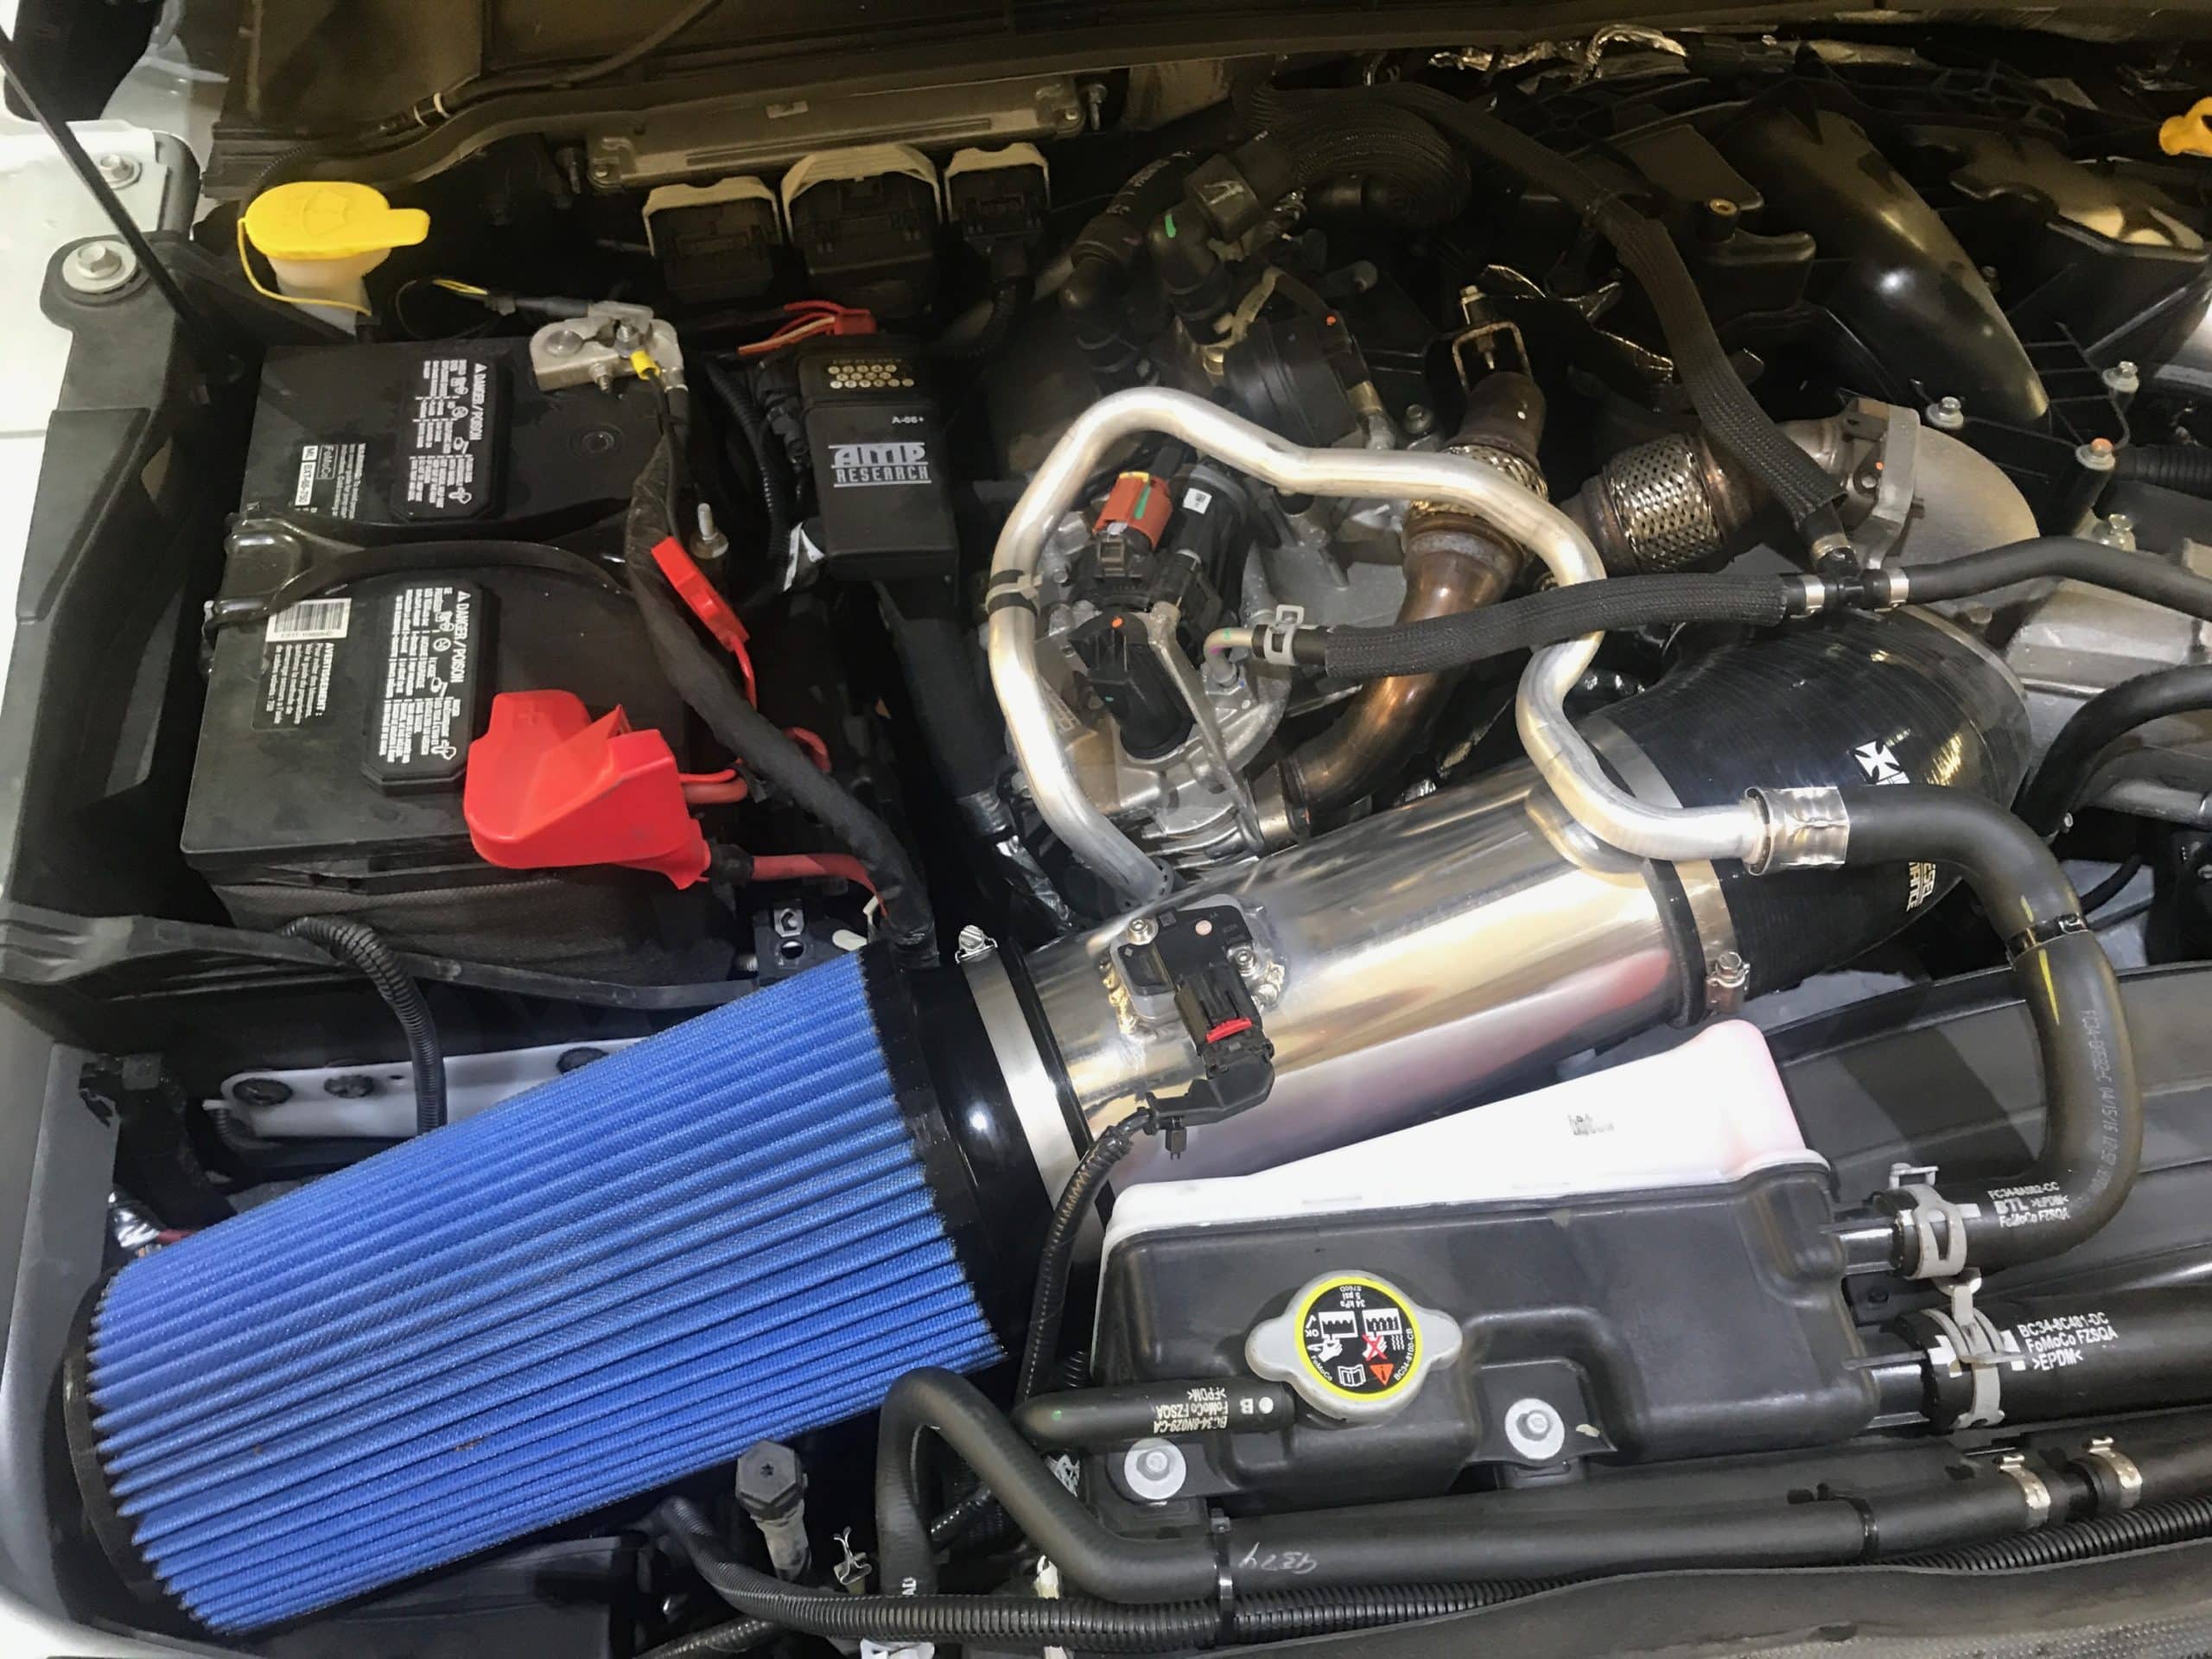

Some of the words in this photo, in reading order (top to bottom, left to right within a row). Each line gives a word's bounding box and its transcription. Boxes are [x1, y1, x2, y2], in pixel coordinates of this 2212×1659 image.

[834, 444, 926, 466] AMP
[836, 466, 930, 483] RESEARCH
[1993, 1197, 2029, 1215] BTL
[1999, 1211, 2037, 1228] FoMoCo
[1305, 1329, 1319, 1338] OK
[2024, 1332, 2076, 1353] FoMoCo
[2075, 1325, 2119, 1344] FZSQA
[1311, 1355, 1333, 1382] FoMoCo
[1155, 1402, 1189, 1420] FZSQA
[1191, 1401, 1229, 1415] FoMoCo
